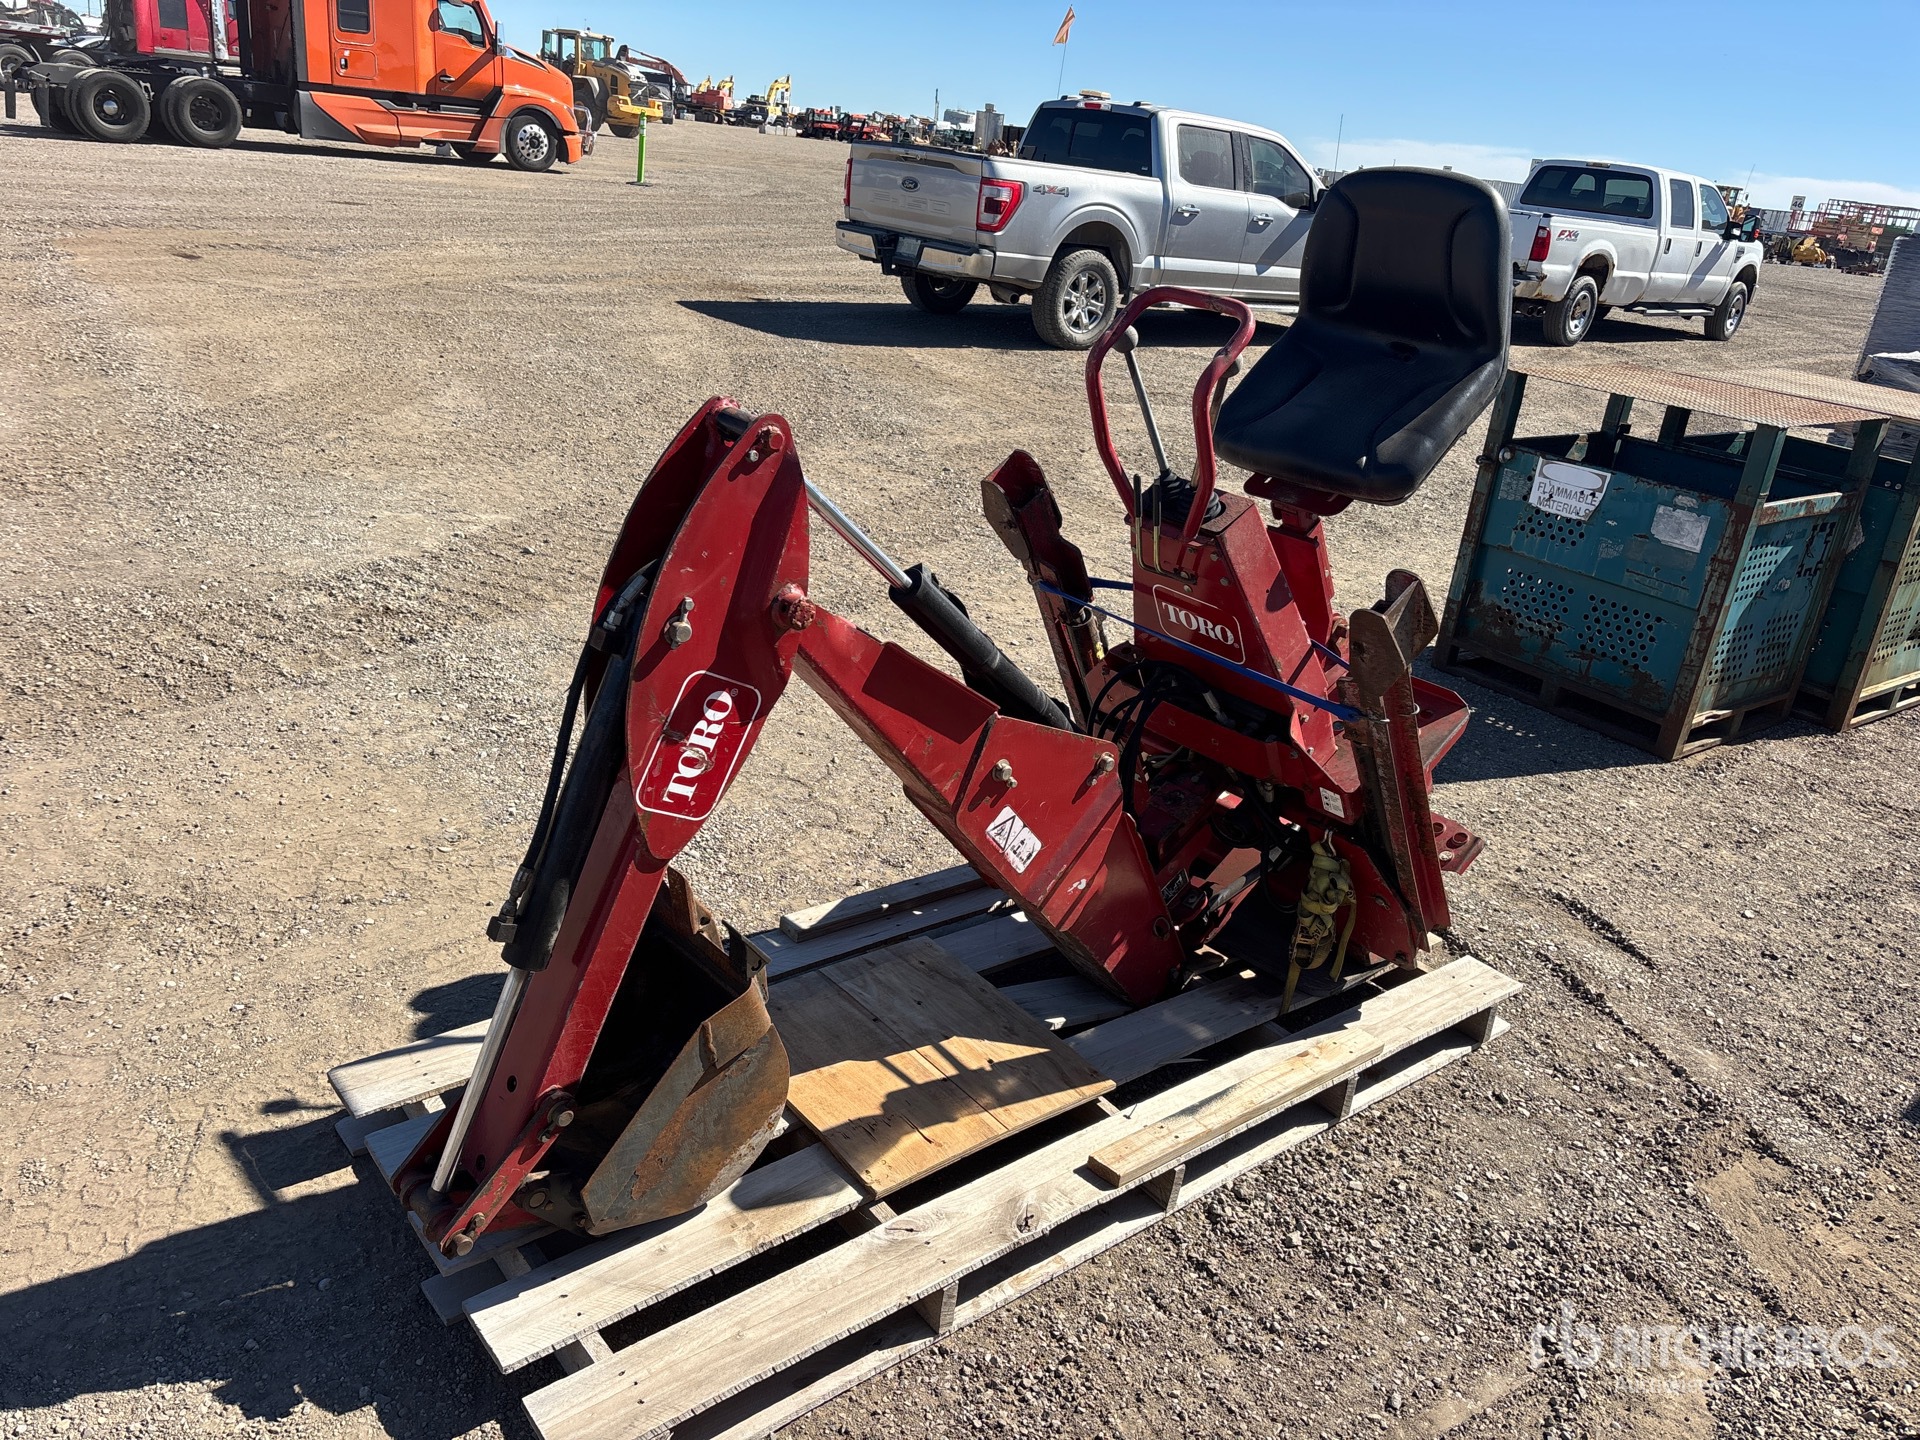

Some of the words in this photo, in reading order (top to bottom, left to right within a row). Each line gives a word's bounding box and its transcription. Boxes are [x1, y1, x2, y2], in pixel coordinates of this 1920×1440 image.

[1558, 230, 1580, 238] FX4
[1536, 481, 1599, 507] FLAMMABLE
[1161, 601, 1236, 646] TORO
[662, 690, 734, 804] TORO
